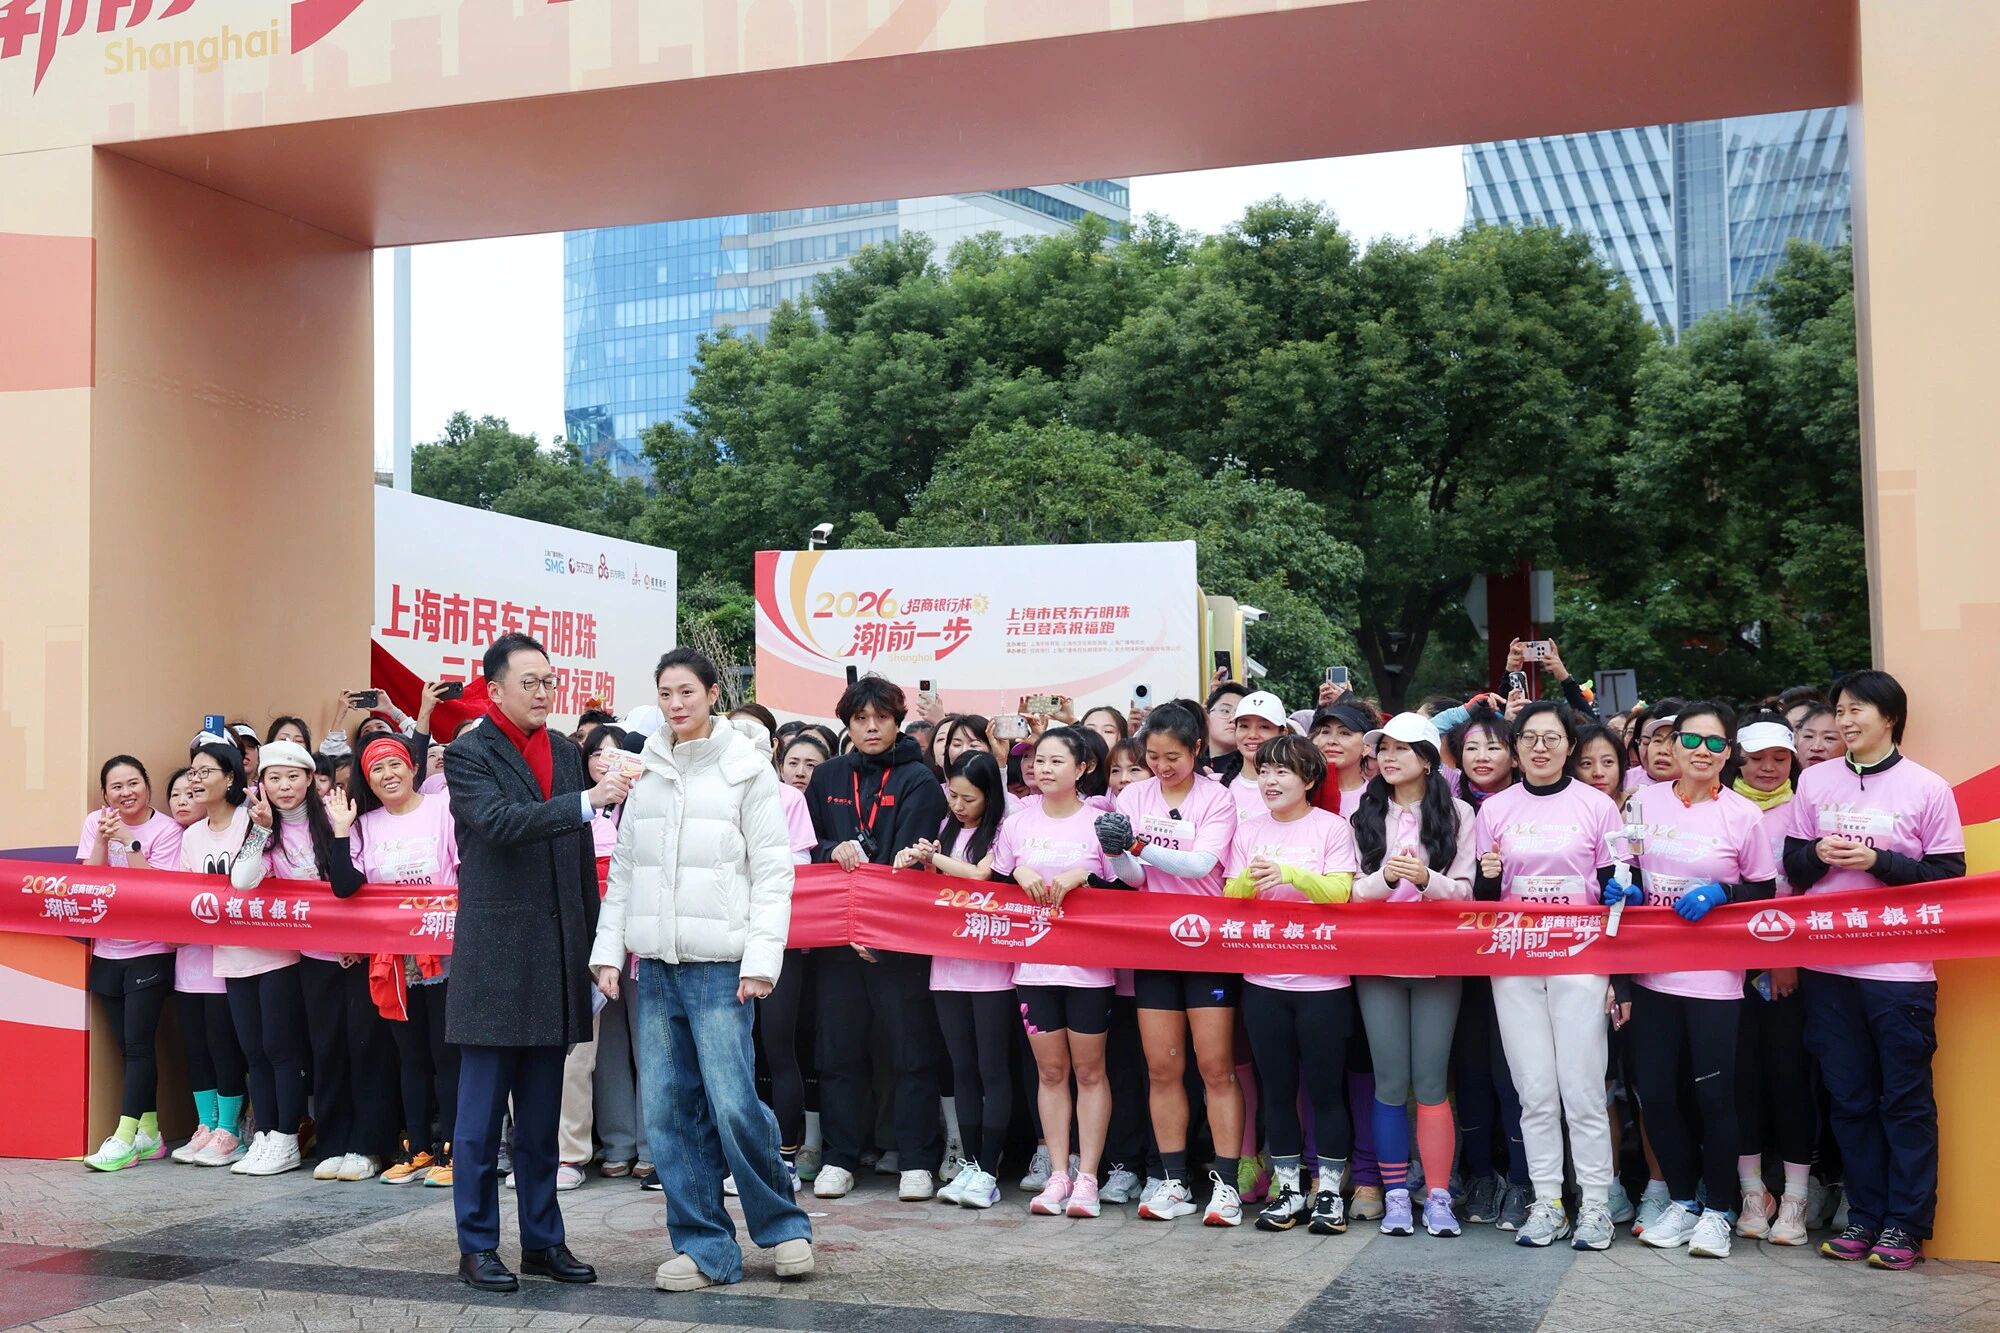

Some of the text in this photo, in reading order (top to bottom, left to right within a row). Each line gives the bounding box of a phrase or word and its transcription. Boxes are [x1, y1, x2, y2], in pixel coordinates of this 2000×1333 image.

[104, 19, 279, 75] Shanghai
[545, 558, 565, 574] SMG
[813, 588, 973, 619] 2026 招商银行杯
[1006, 606, 1130, 620] 上海市民东方明珠
[381, 583, 597, 659] 上海市民东方明珠
[1006, 621, 1115, 635] 元旦登高祝福跑
[843, 617, 973, 663] 潮前一步
[888, 652, 933, 664] Shanghai
[21, 874, 68, 897] 2026
[40, 898, 108, 924] 潮前一步
[934, 888, 1000, 912] 2026
[952, 912, 1052, 947] 潮前一步
[1456, 912, 1601, 930] 2026 招商银行杯
[991, 937, 1025, 947] Shanghai
[1477, 926, 1602, 960] 潮前一步
[1844, 930, 1913, 939] MERCHANTS
[1525, 949, 1568, 960] Shanghai
